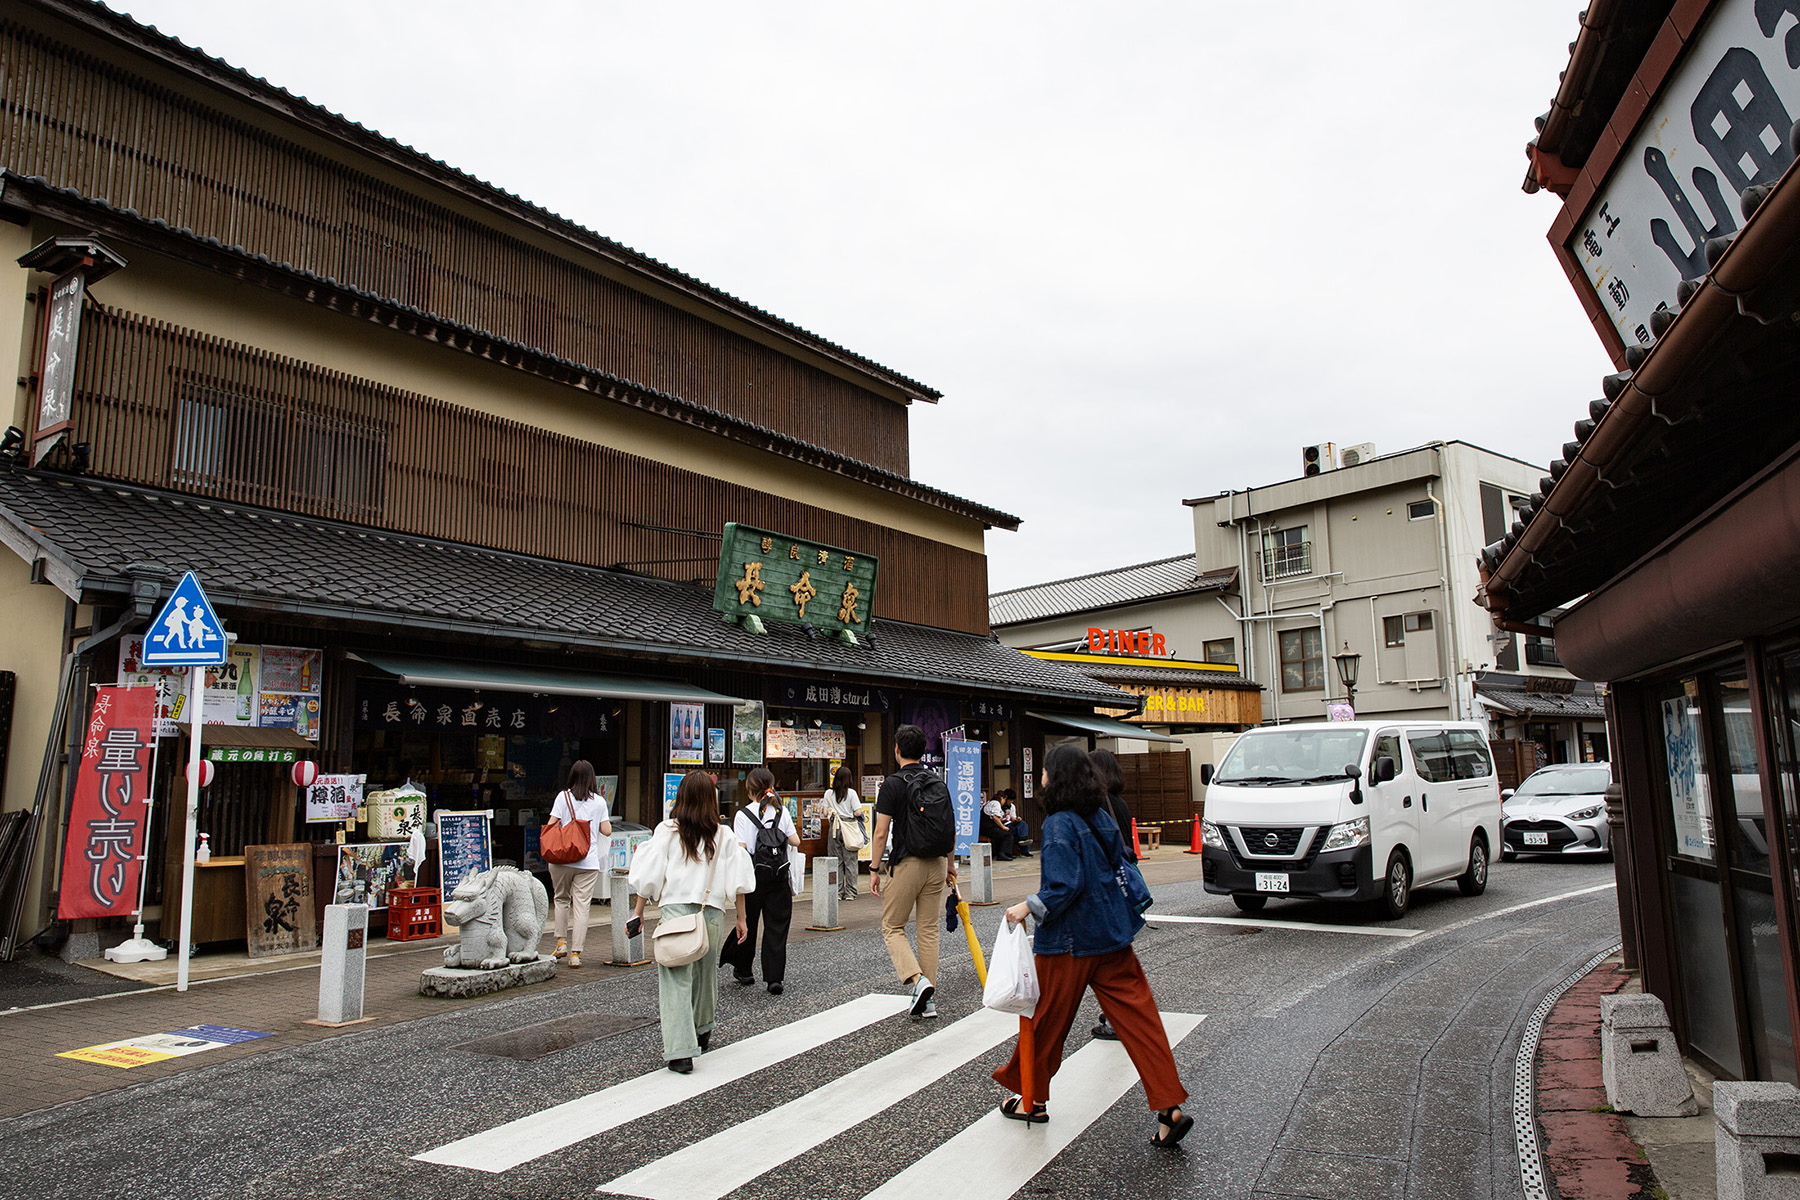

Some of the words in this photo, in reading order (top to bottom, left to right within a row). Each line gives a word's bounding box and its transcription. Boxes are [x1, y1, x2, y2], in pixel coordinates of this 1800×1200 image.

[735, 561, 862, 625] 長命泉
[1088, 627, 1167, 656] DINER
[842, 690, 870, 706] stand
[1144, 695, 1164, 711] ER
[1166, 695, 1177, 711] &
[1178, 696, 1205, 712] BAR
[382, 701, 526, 729] 長命泉直売店
[211, 749, 293, 761] 蔵元の角打ち
[315, 777, 343, 785] 元直送!!
[310, 785, 346, 805] 樽酒
[955, 760, 975, 837] 酒蔵の甘酒
[1263, 880, 1288, 891] 31-24
